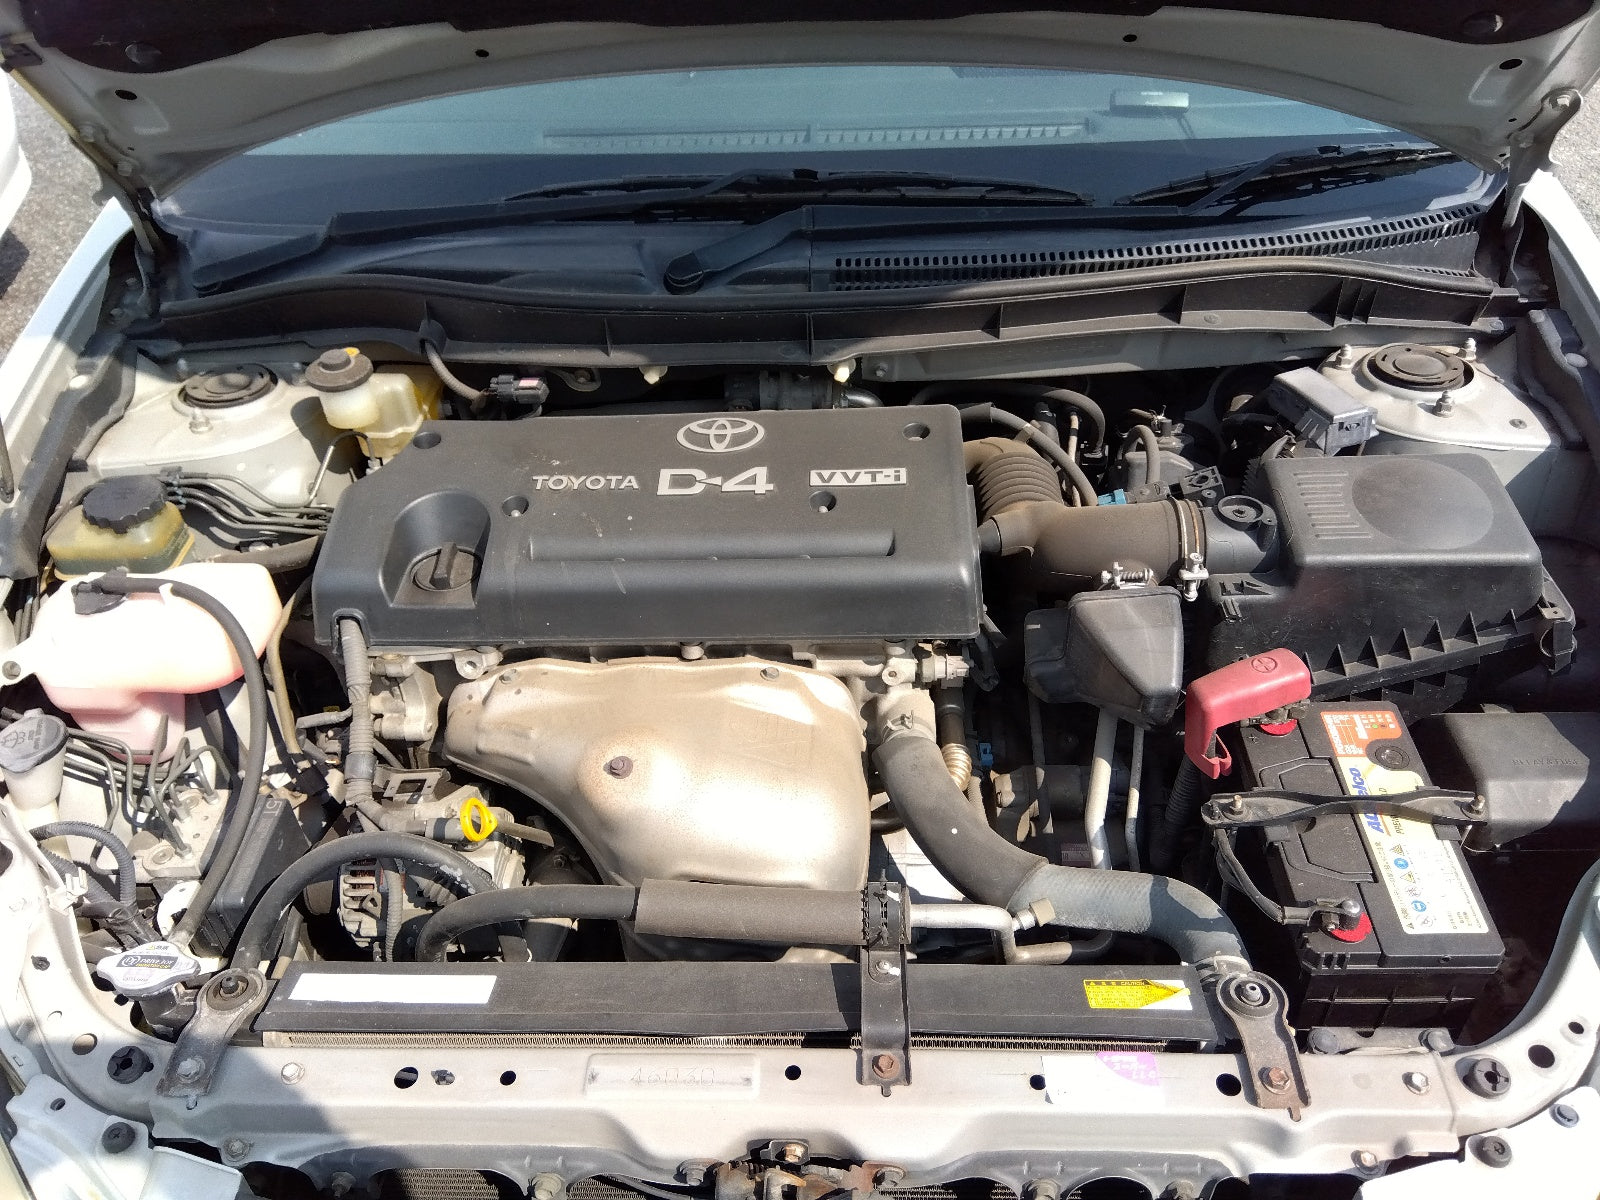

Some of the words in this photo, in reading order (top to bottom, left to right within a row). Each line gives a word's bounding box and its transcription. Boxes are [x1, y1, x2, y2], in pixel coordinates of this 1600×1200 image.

[532, 475, 640, 490] TOYOTA
[657, 466, 774, 495] D-4
[814, 469, 902, 485] VVT-i
[1349, 768, 1385, 834] ACelco
